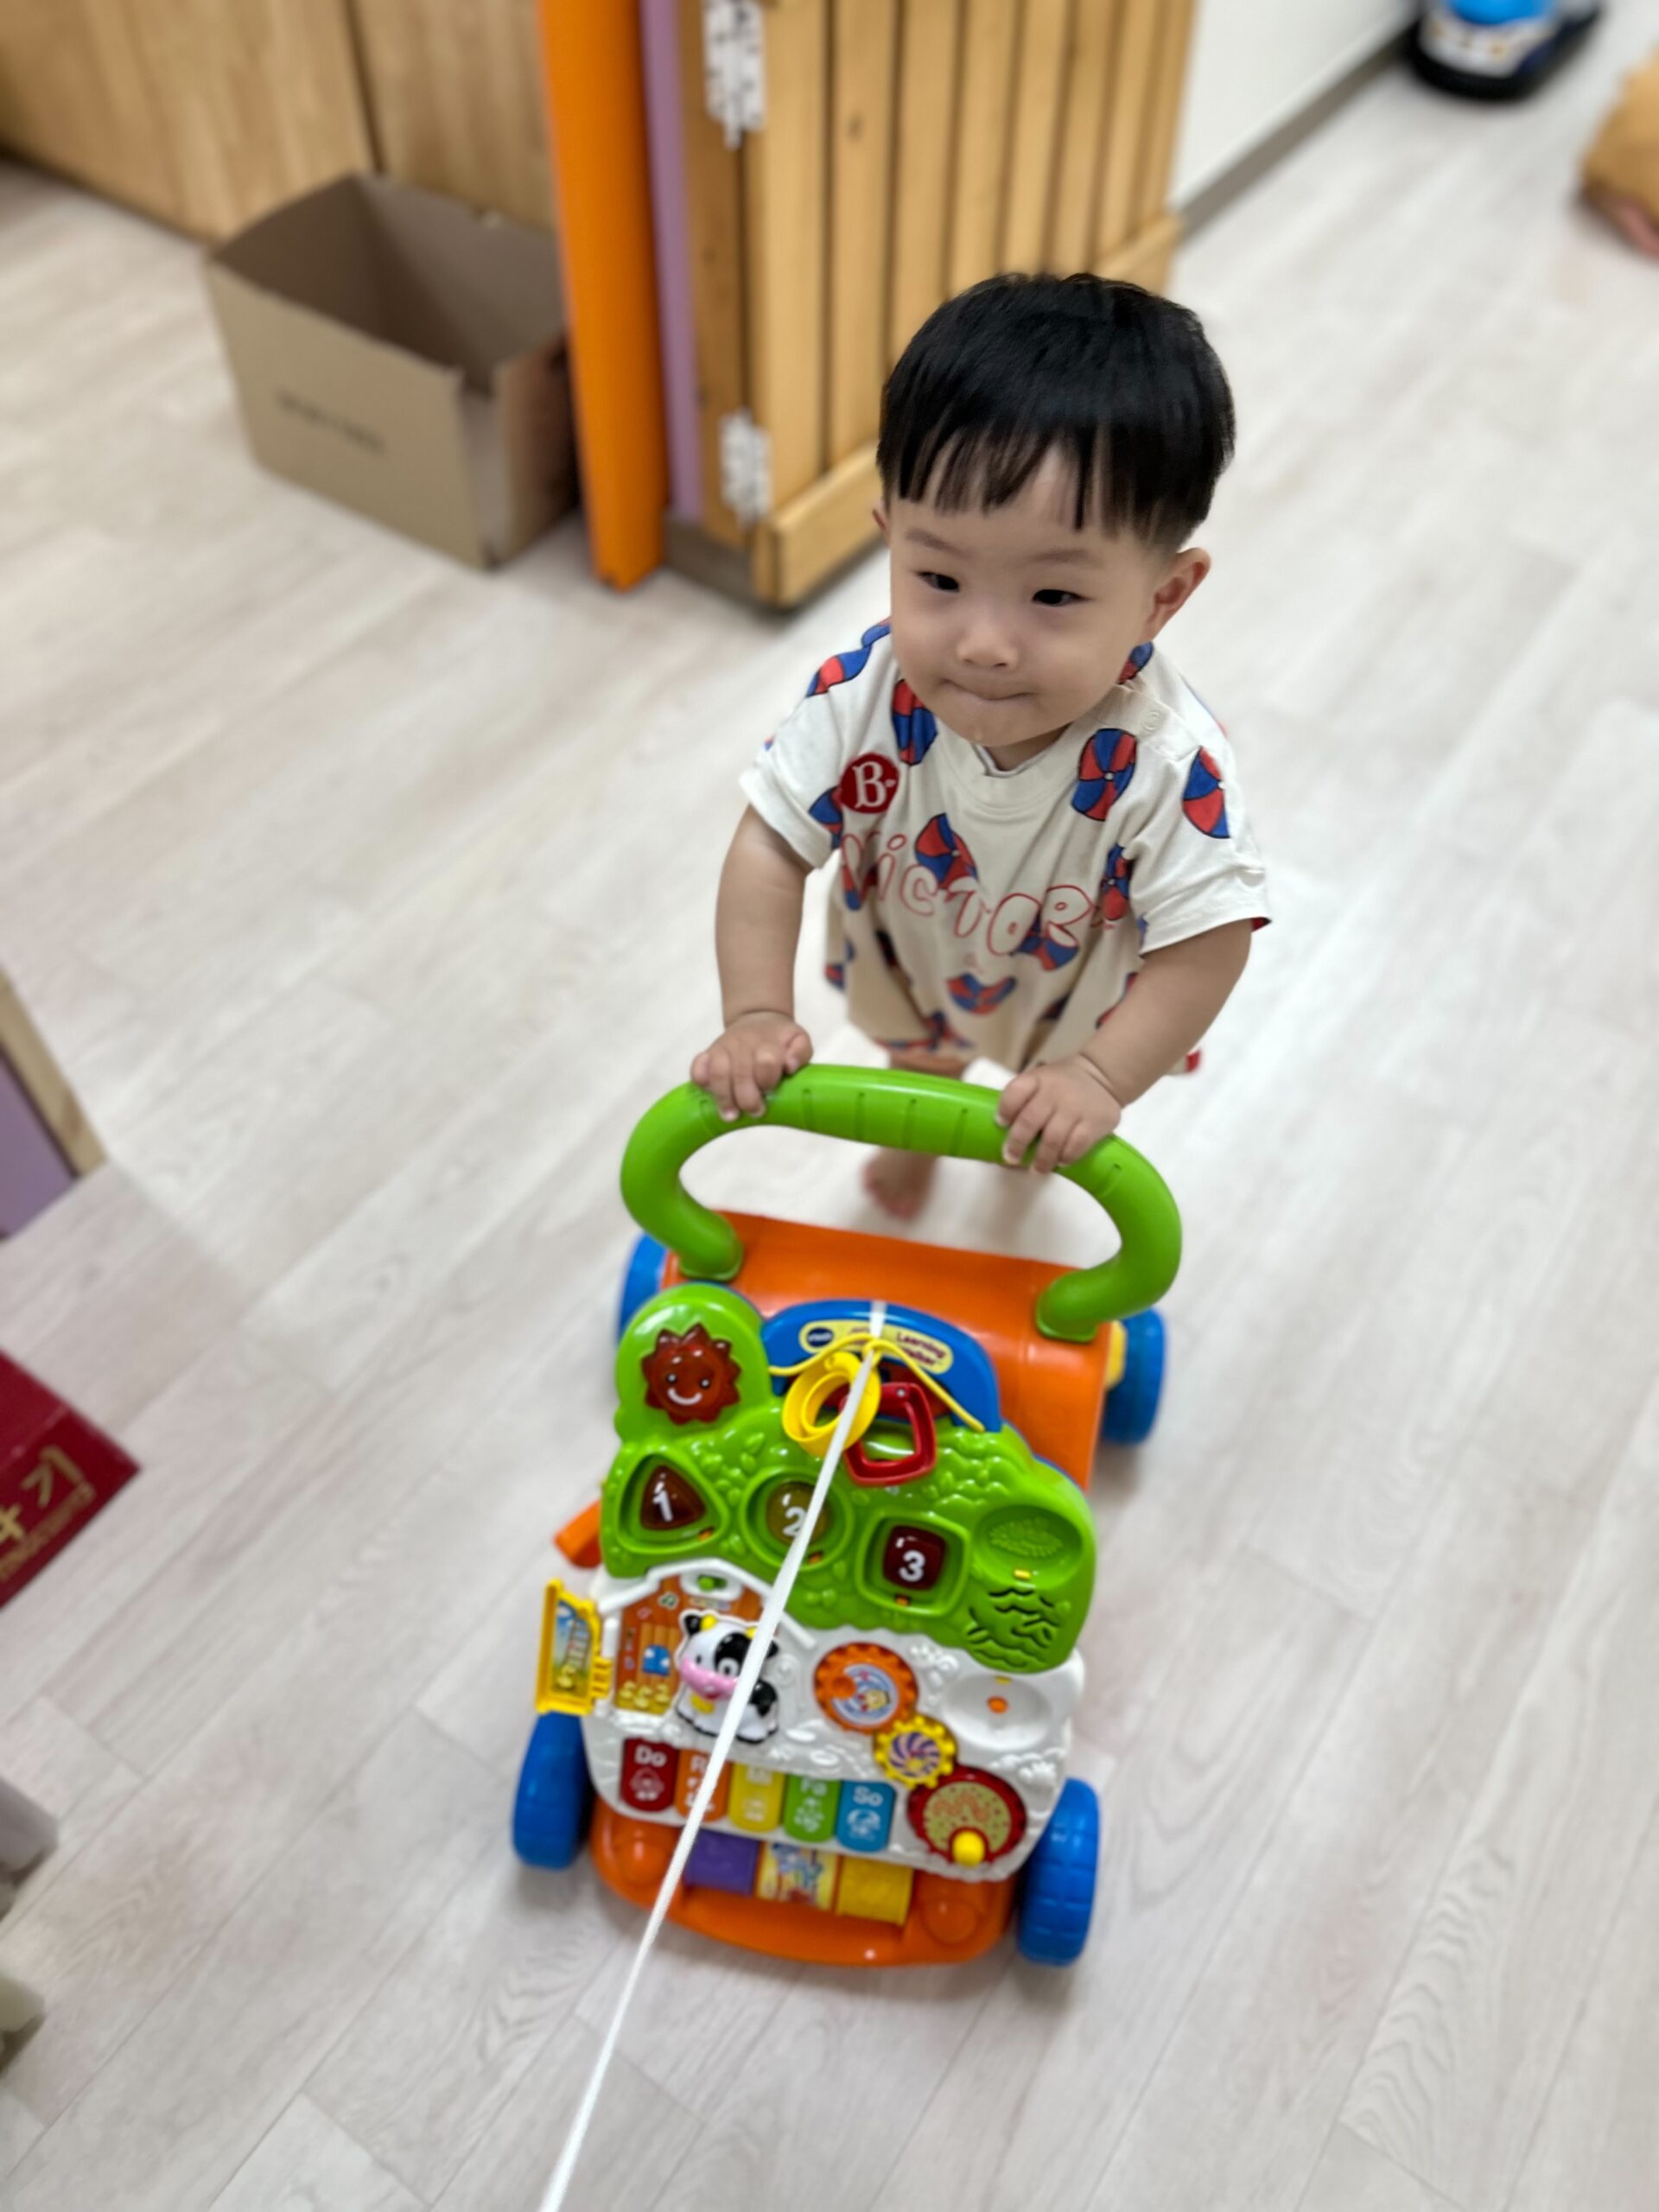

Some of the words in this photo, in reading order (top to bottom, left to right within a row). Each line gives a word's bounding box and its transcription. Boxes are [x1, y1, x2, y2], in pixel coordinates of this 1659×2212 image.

[652, 1490, 673, 1522] 1
[782, 1506, 807, 1537] 2
[899, 1550, 926, 1582] 3
[634, 1744, 668, 1768] Do
[852, 1785, 884, 1808] So
